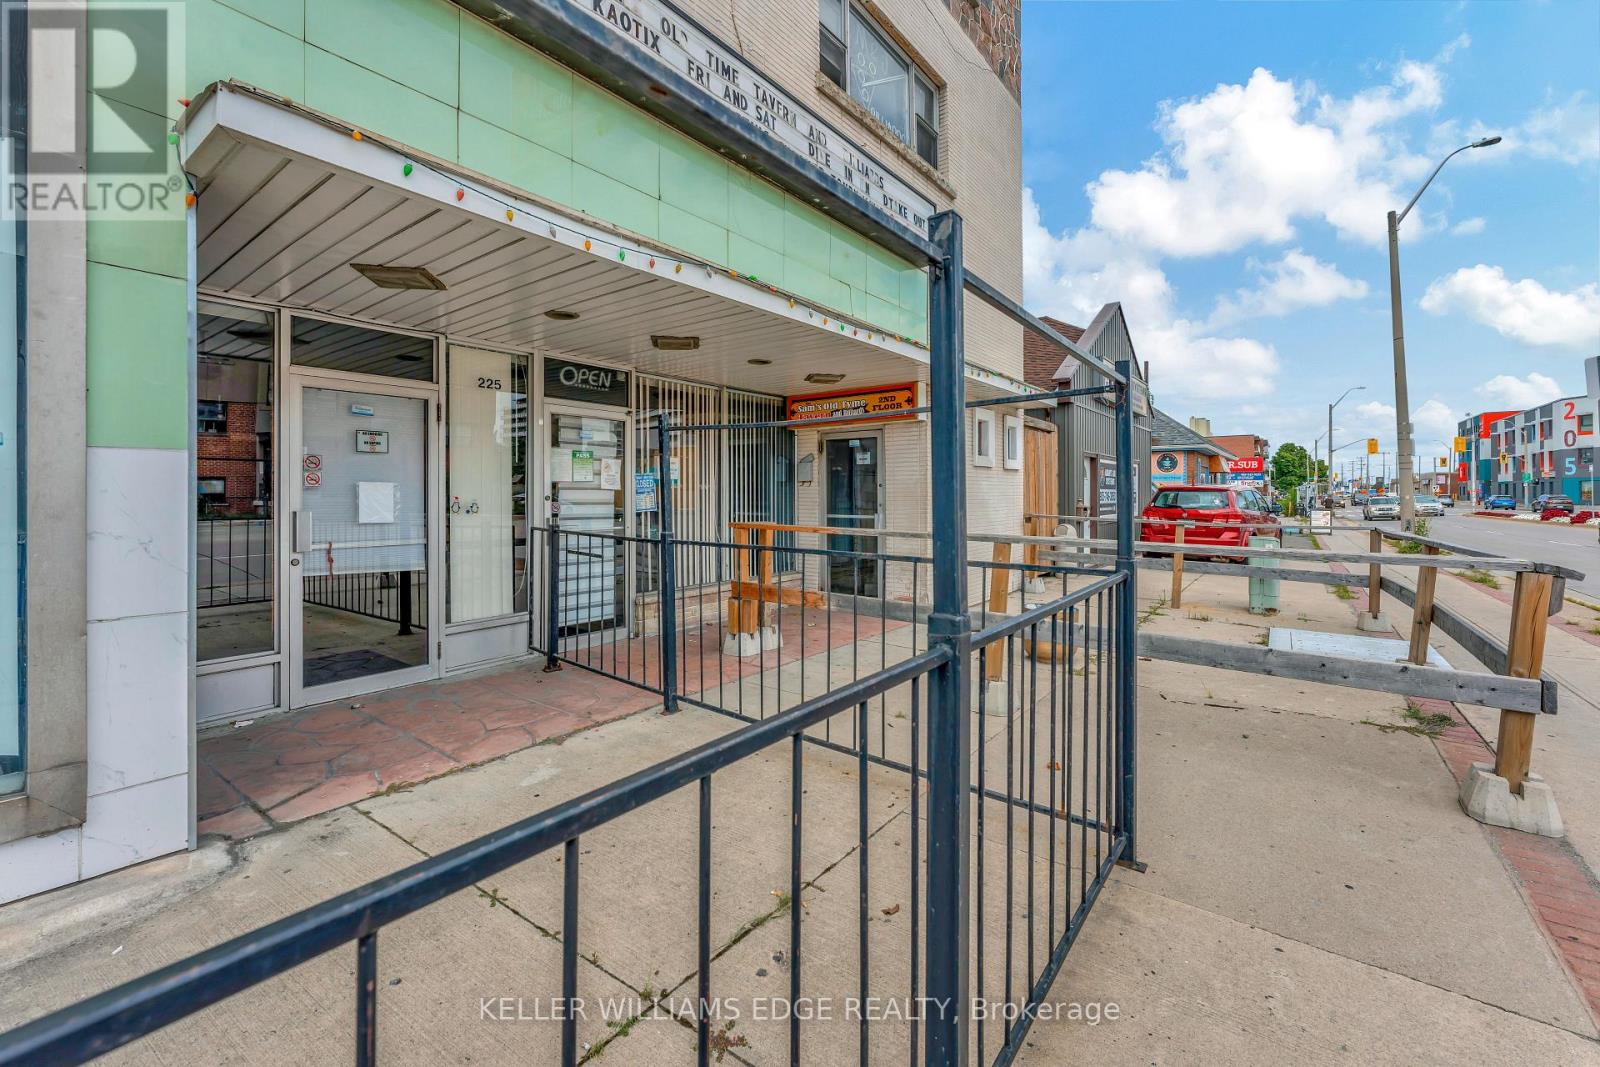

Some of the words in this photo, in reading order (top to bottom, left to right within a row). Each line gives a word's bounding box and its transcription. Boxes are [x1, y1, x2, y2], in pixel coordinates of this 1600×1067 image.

[687, 59, 711, 88] FRI
[724, 85, 748, 110] AND
[755, 105, 777, 130] SAT
[809, 142, 831, 168] DIE
[560, 366, 611, 387] OPEN
[478, 377, 502, 390] 225
[878, 395, 896, 403] 2ND
[823, 402, 839, 410] Old
[872, 402, 903, 411] FLOOR
[1227, 461, 1259, 469] R.SUB
